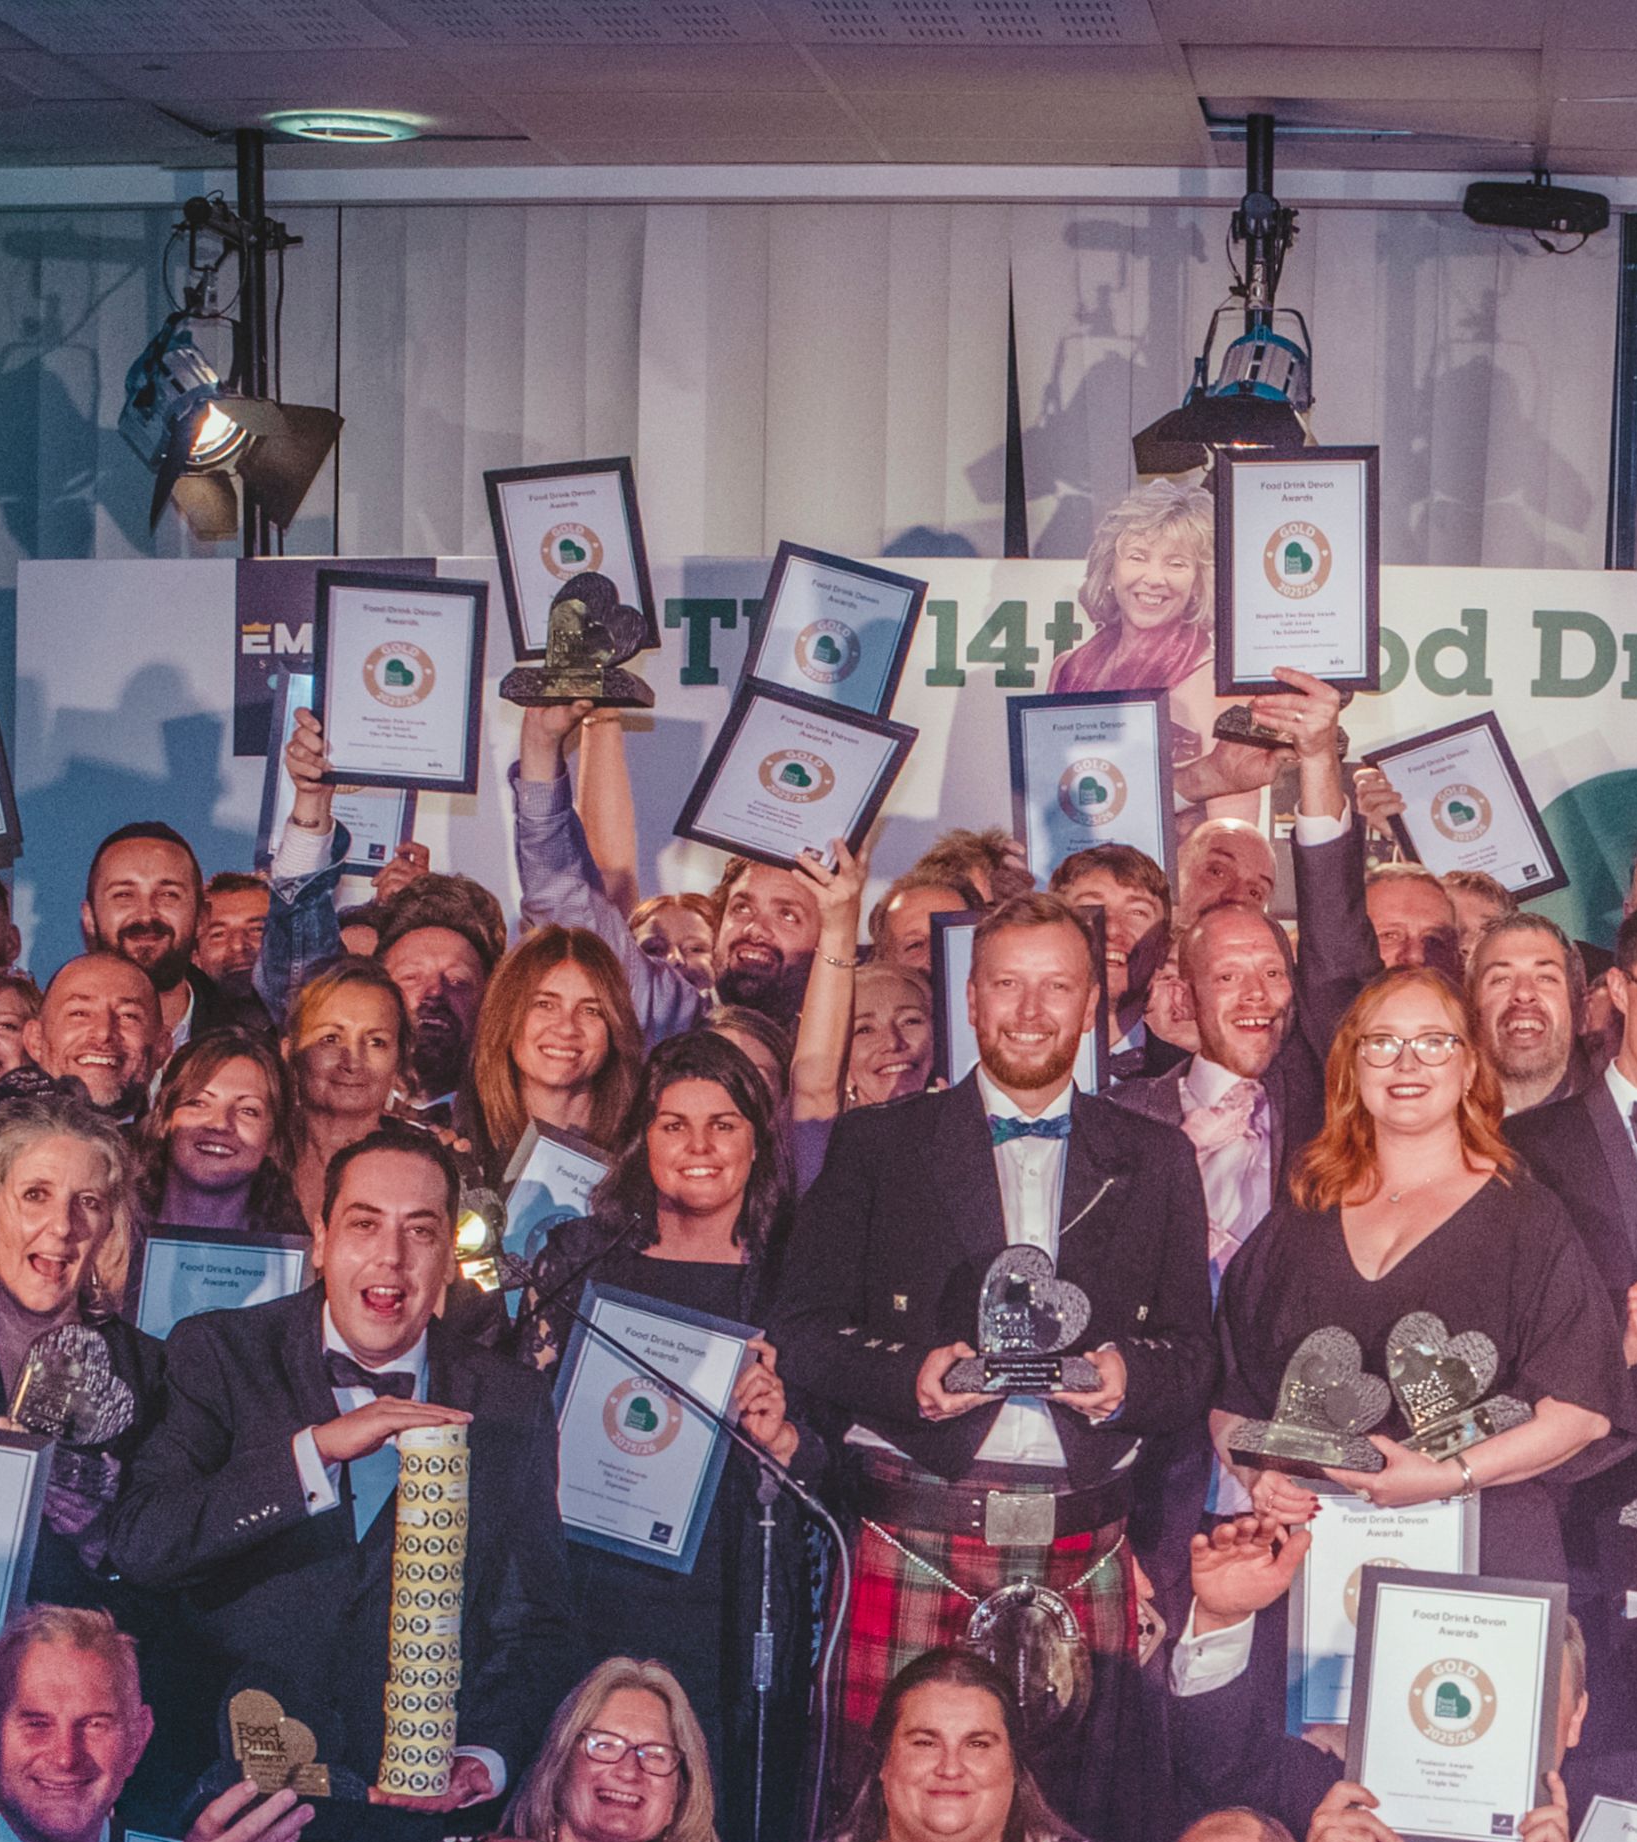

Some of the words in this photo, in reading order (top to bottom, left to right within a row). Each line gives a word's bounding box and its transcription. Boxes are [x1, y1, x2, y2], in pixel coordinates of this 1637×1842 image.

[1411, 1608, 1440, 1621] Food
[1440, 1611, 1470, 1623] Drink
[1471, 1613, 1507, 1627] Devon
[1437, 1625, 1479, 1639] Awards
[1430, 1660, 1480, 1680] GOLD
[1421, 1724, 1477, 1745] 2025/26
